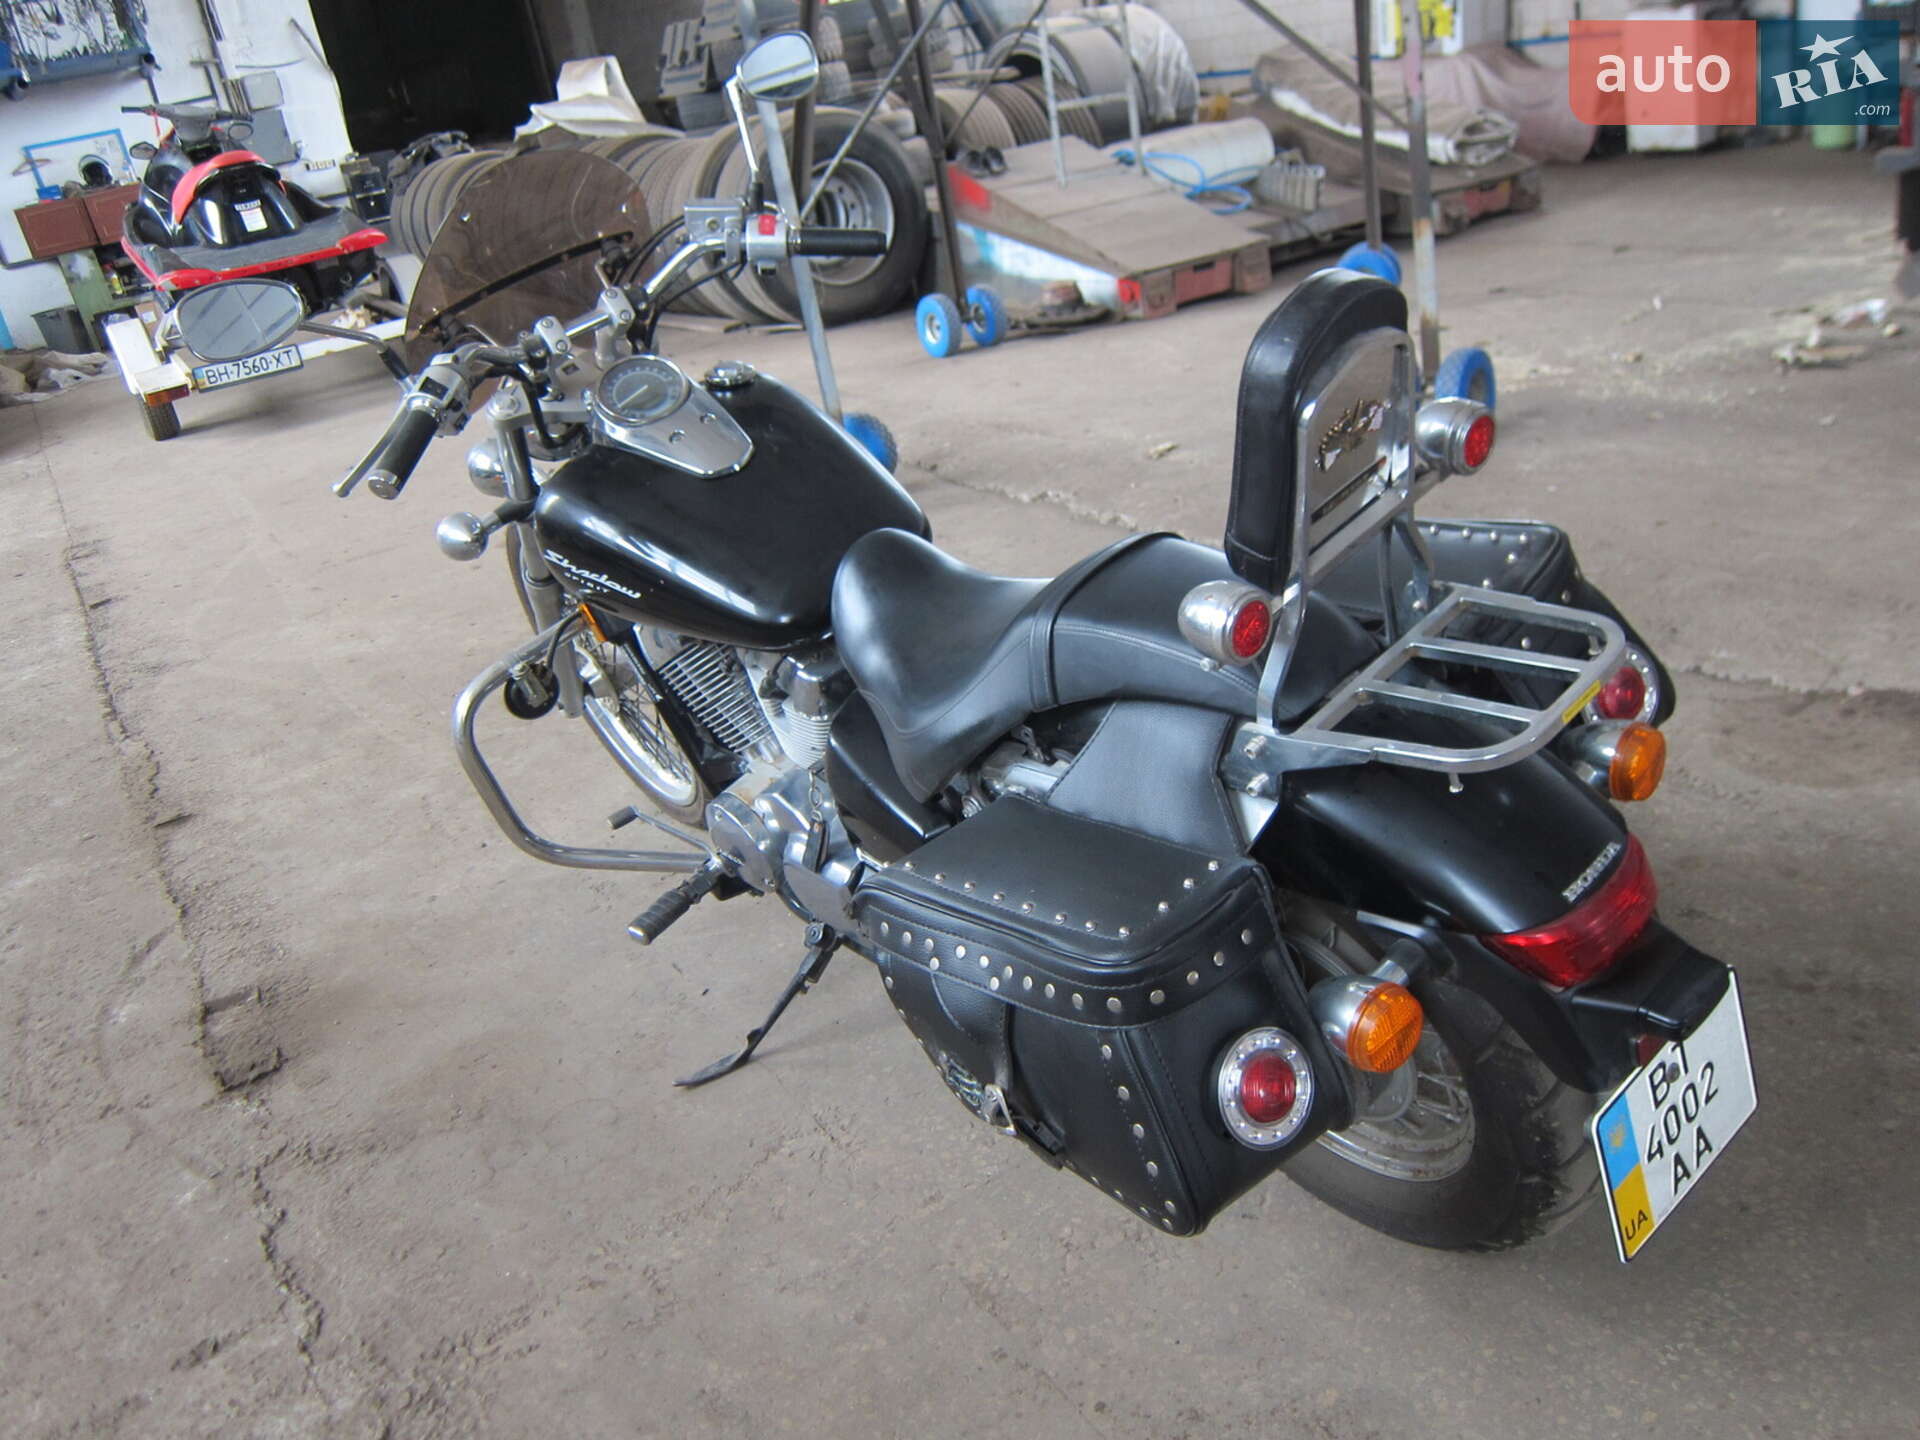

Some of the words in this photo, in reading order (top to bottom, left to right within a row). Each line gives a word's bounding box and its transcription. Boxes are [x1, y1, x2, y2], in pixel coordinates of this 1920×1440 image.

[544, 549, 642, 599] Shadow
[1562, 842, 1621, 902] HONDA
[1646, 1061, 1719, 1164] 4002
[1672, 1124, 1713, 1196] AA
[1624, 1209, 1649, 1241] UA
